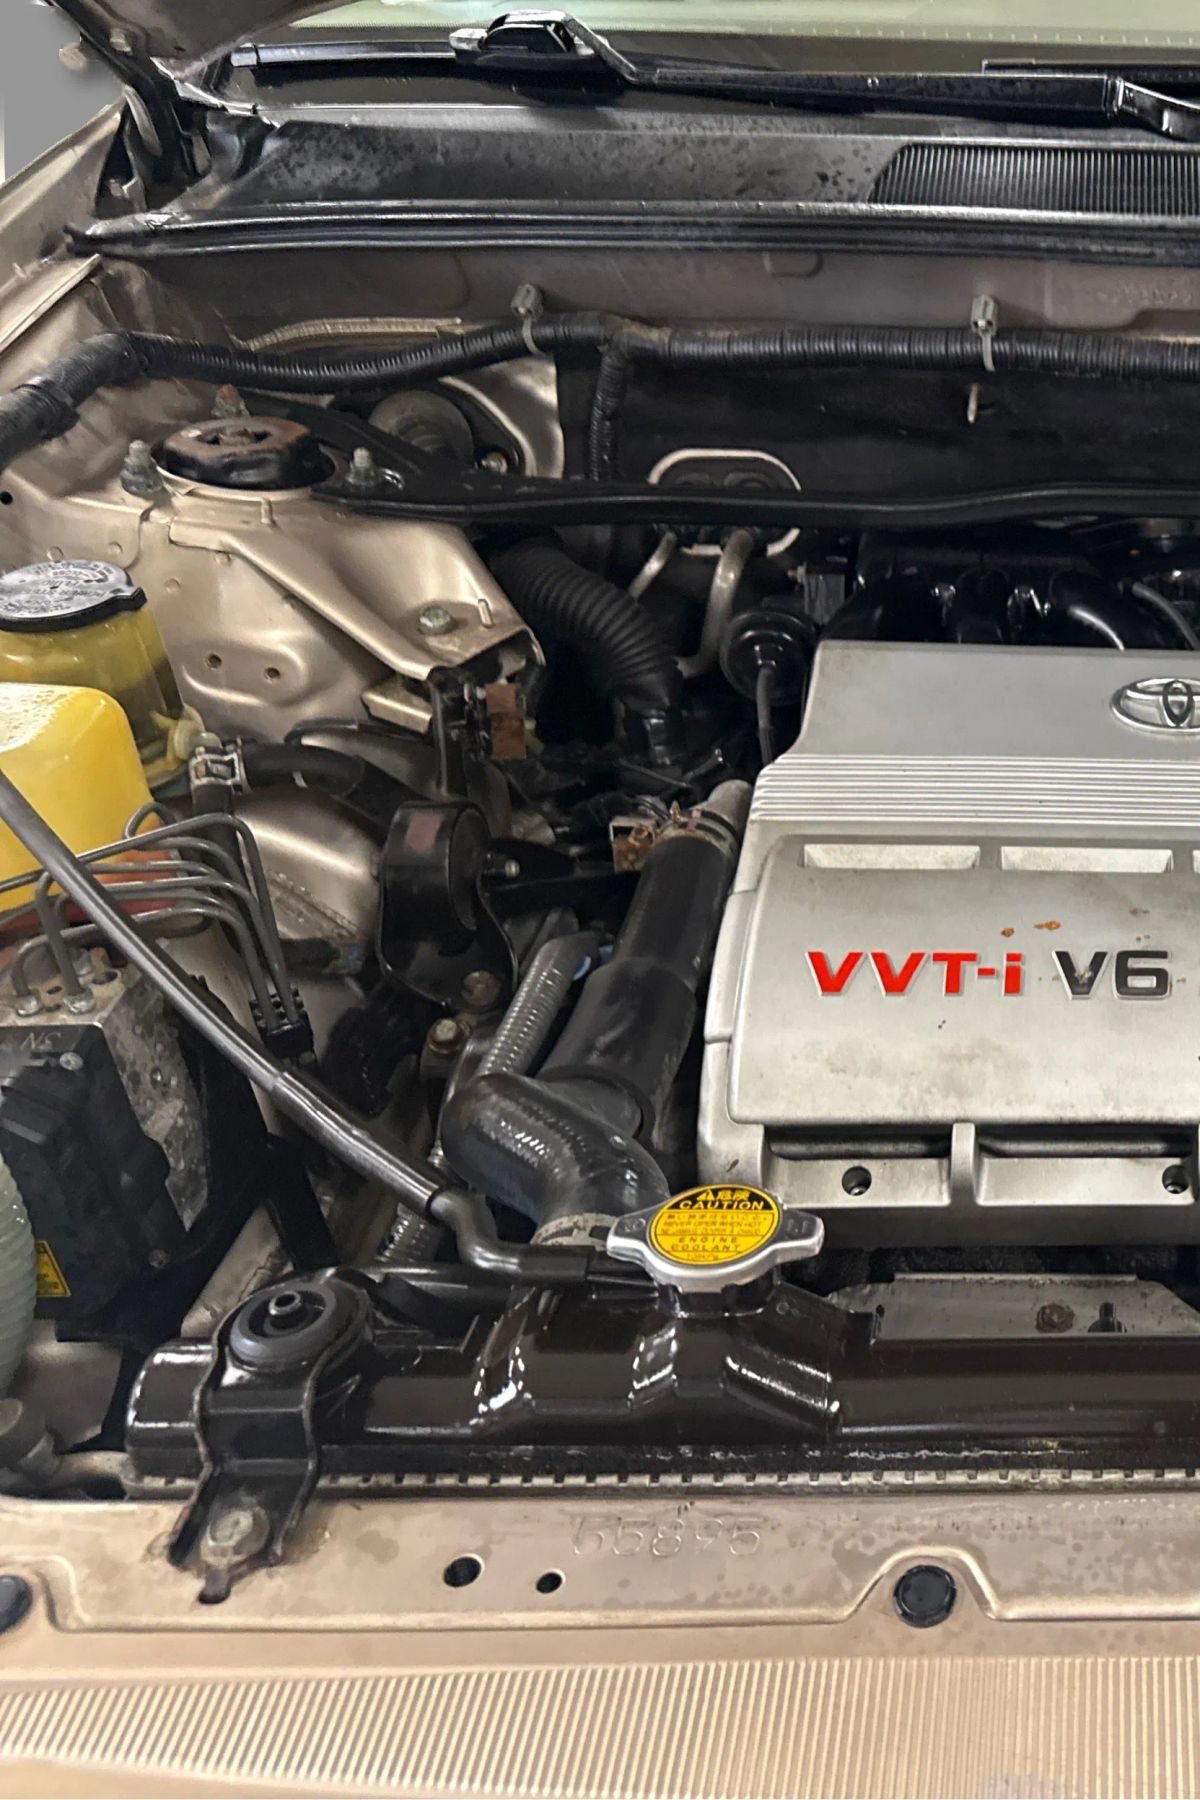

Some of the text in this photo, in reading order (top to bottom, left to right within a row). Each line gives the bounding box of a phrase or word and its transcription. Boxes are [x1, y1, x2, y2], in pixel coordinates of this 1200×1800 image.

[806, 950, 1025, 998] VVT-i
[1052, 949, 1172, 1000] V6
[679, 1200, 764, 1210] CAUTION
